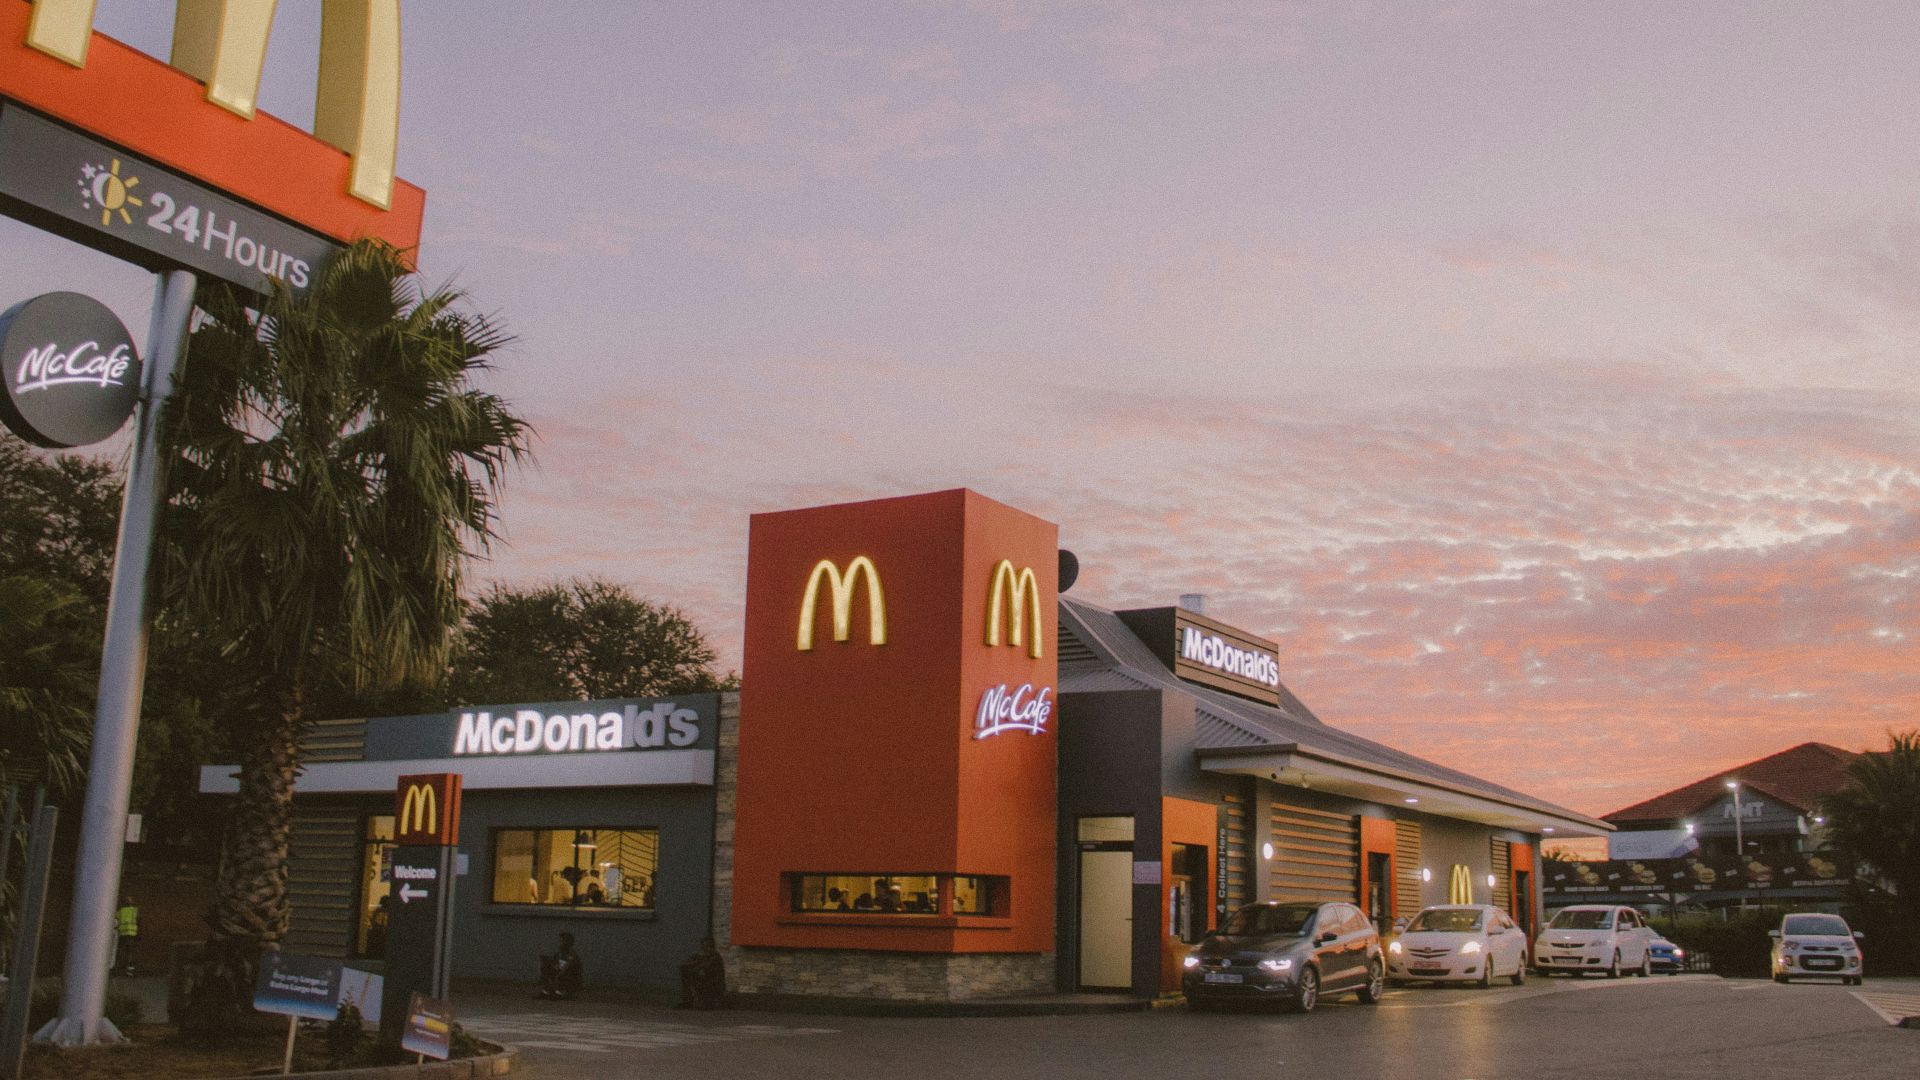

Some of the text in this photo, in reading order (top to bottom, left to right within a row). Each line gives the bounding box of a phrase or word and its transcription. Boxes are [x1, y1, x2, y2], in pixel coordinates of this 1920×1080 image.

[147, 192, 311, 289] 24 Hours
[16, 341, 130, 392] McCafé
[1182, 626, 1279, 687] McDonald's
[453, 702, 700, 755] McDonald's
[974, 684, 1052, 740] McCafé
[1218, 827, 1226, 855] Here
[394, 864, 437, 879] Welcome
[1218, 857, 1226, 898] Collect
